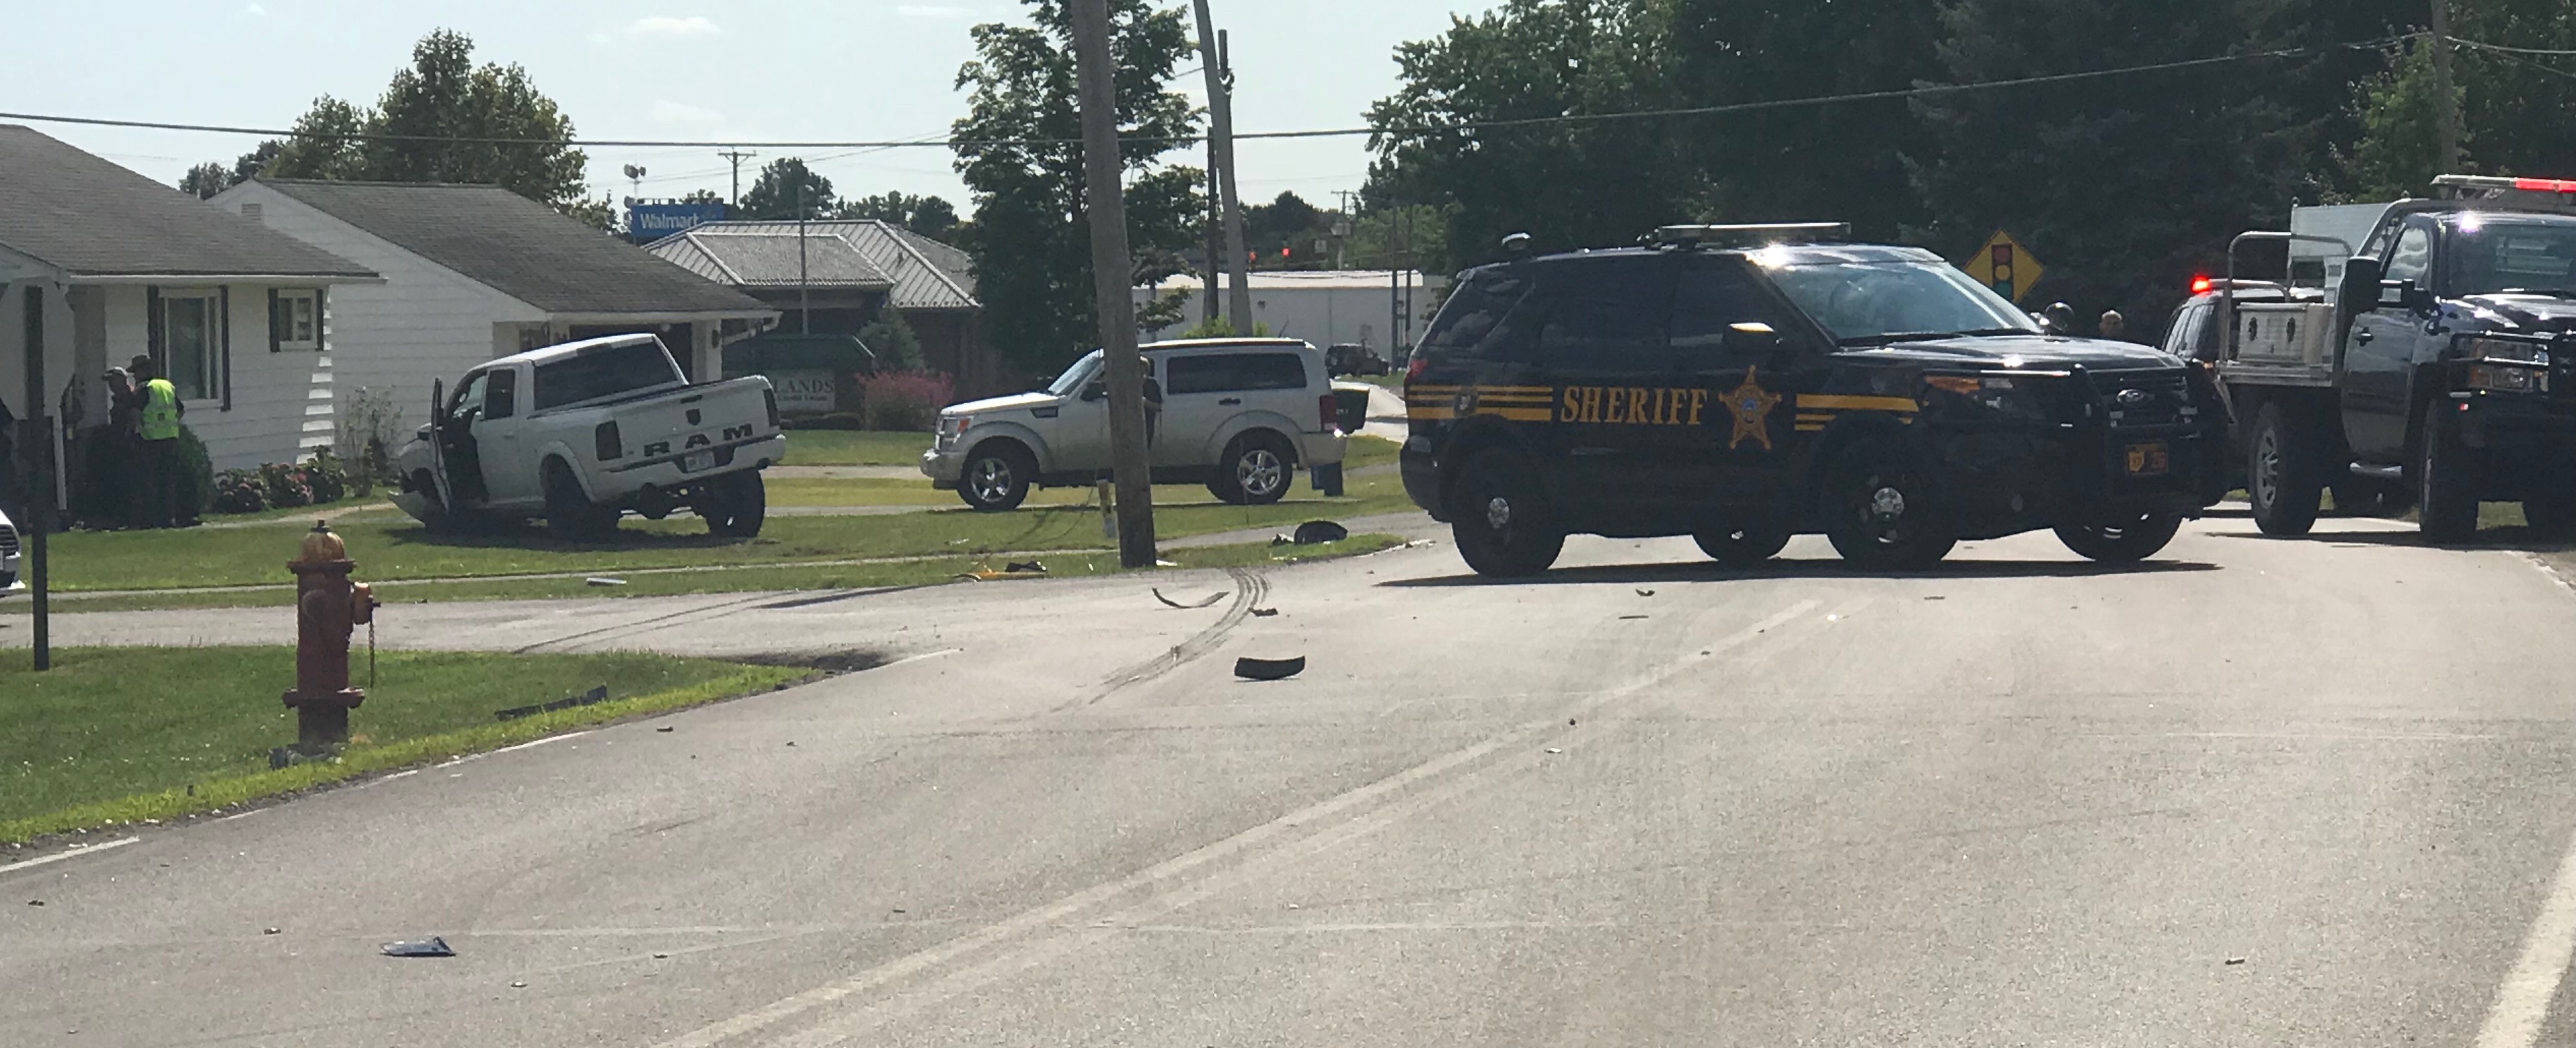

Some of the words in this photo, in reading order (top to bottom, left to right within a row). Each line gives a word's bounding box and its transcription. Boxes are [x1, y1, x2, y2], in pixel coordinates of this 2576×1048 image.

[640, 212, 699, 229] Walmart
[773, 379, 834, 393] LANDS
[1560, 386, 1707, 425] SHERIFF
[643, 424, 753, 457] RAM
